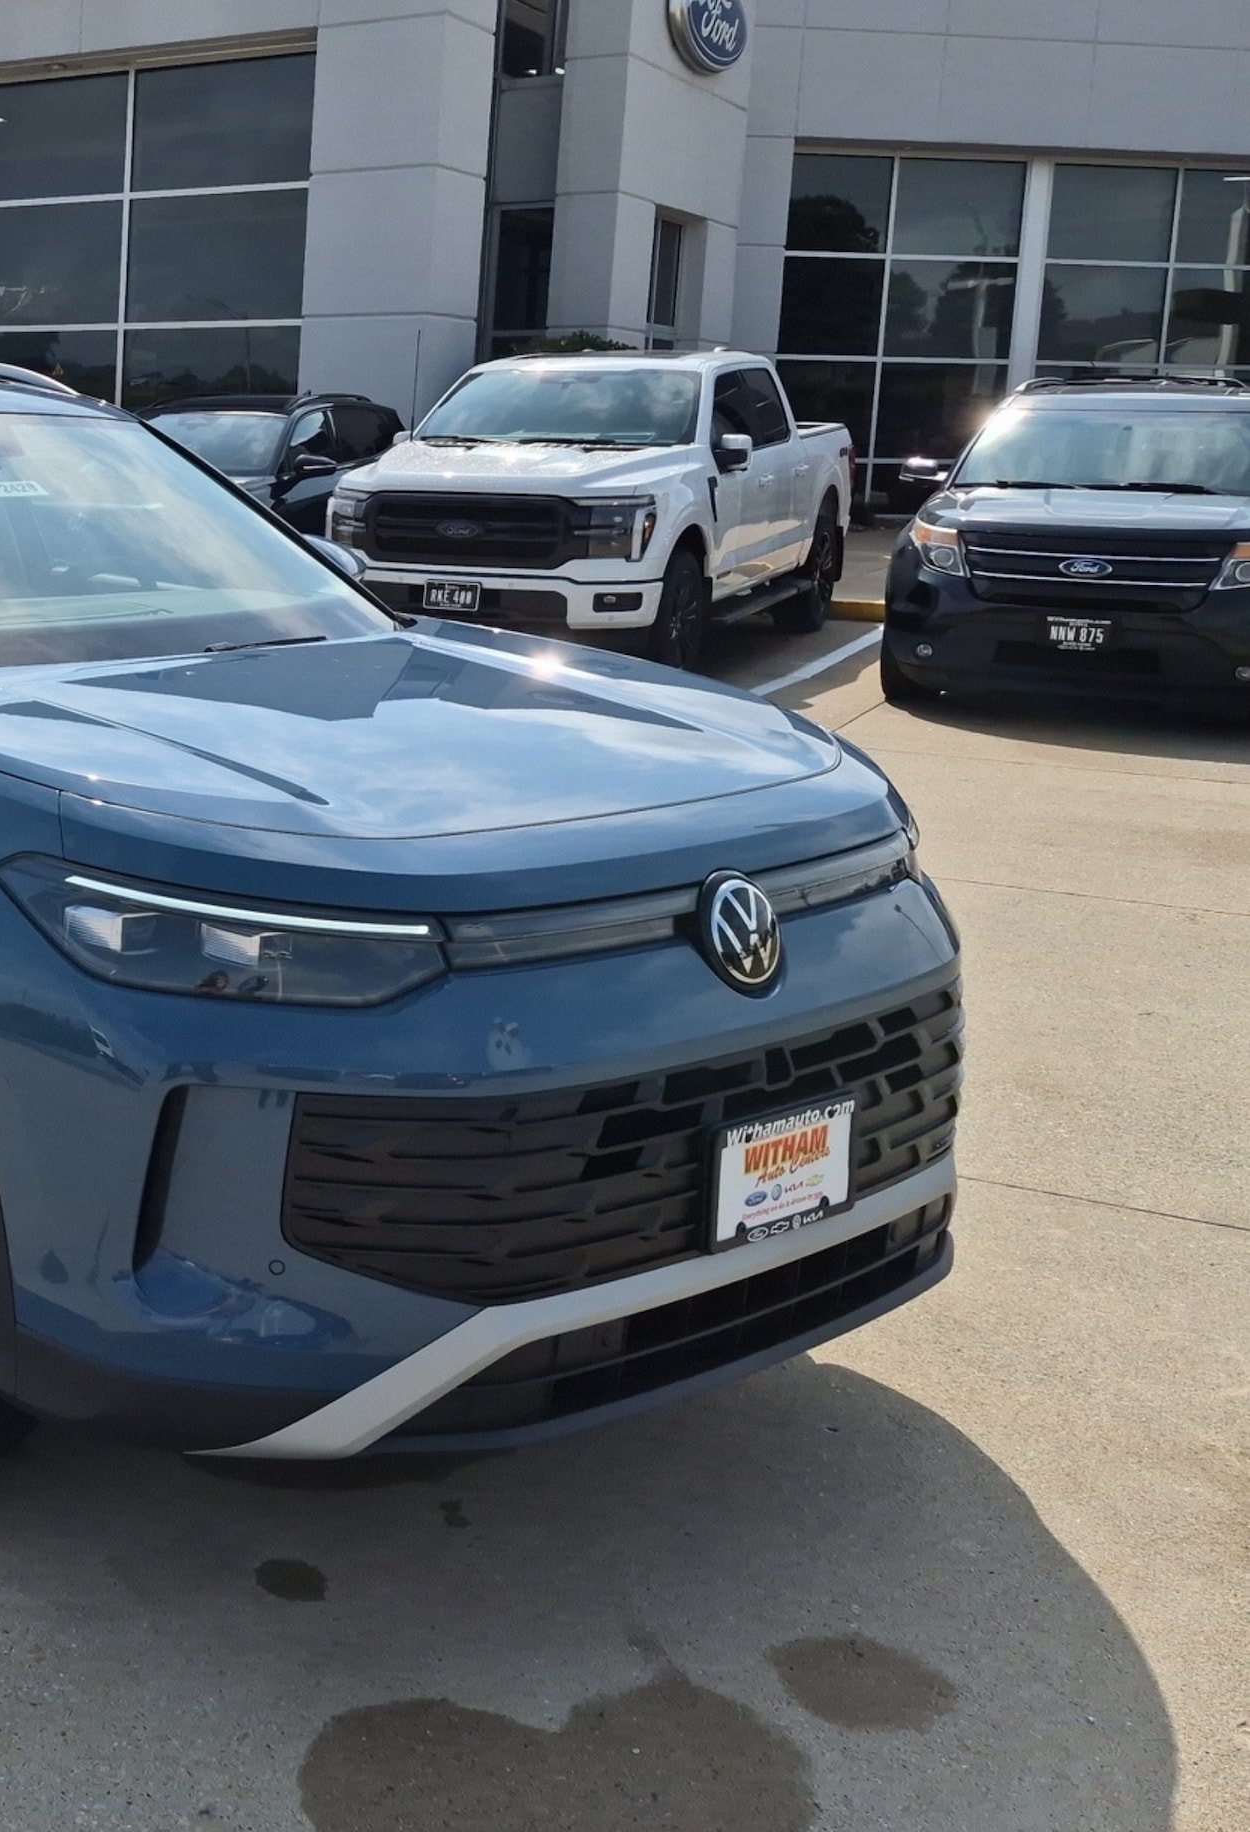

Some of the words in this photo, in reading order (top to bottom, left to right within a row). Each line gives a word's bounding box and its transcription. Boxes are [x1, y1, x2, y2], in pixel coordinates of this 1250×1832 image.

[702, 6, 739, 52] Ford
[1070, 561, 1100, 574] Ford
[1079, 627, 1104, 643] 875
[744, 1123, 830, 1175] WITHAM
[755, 1164, 786, 1188] Auto
